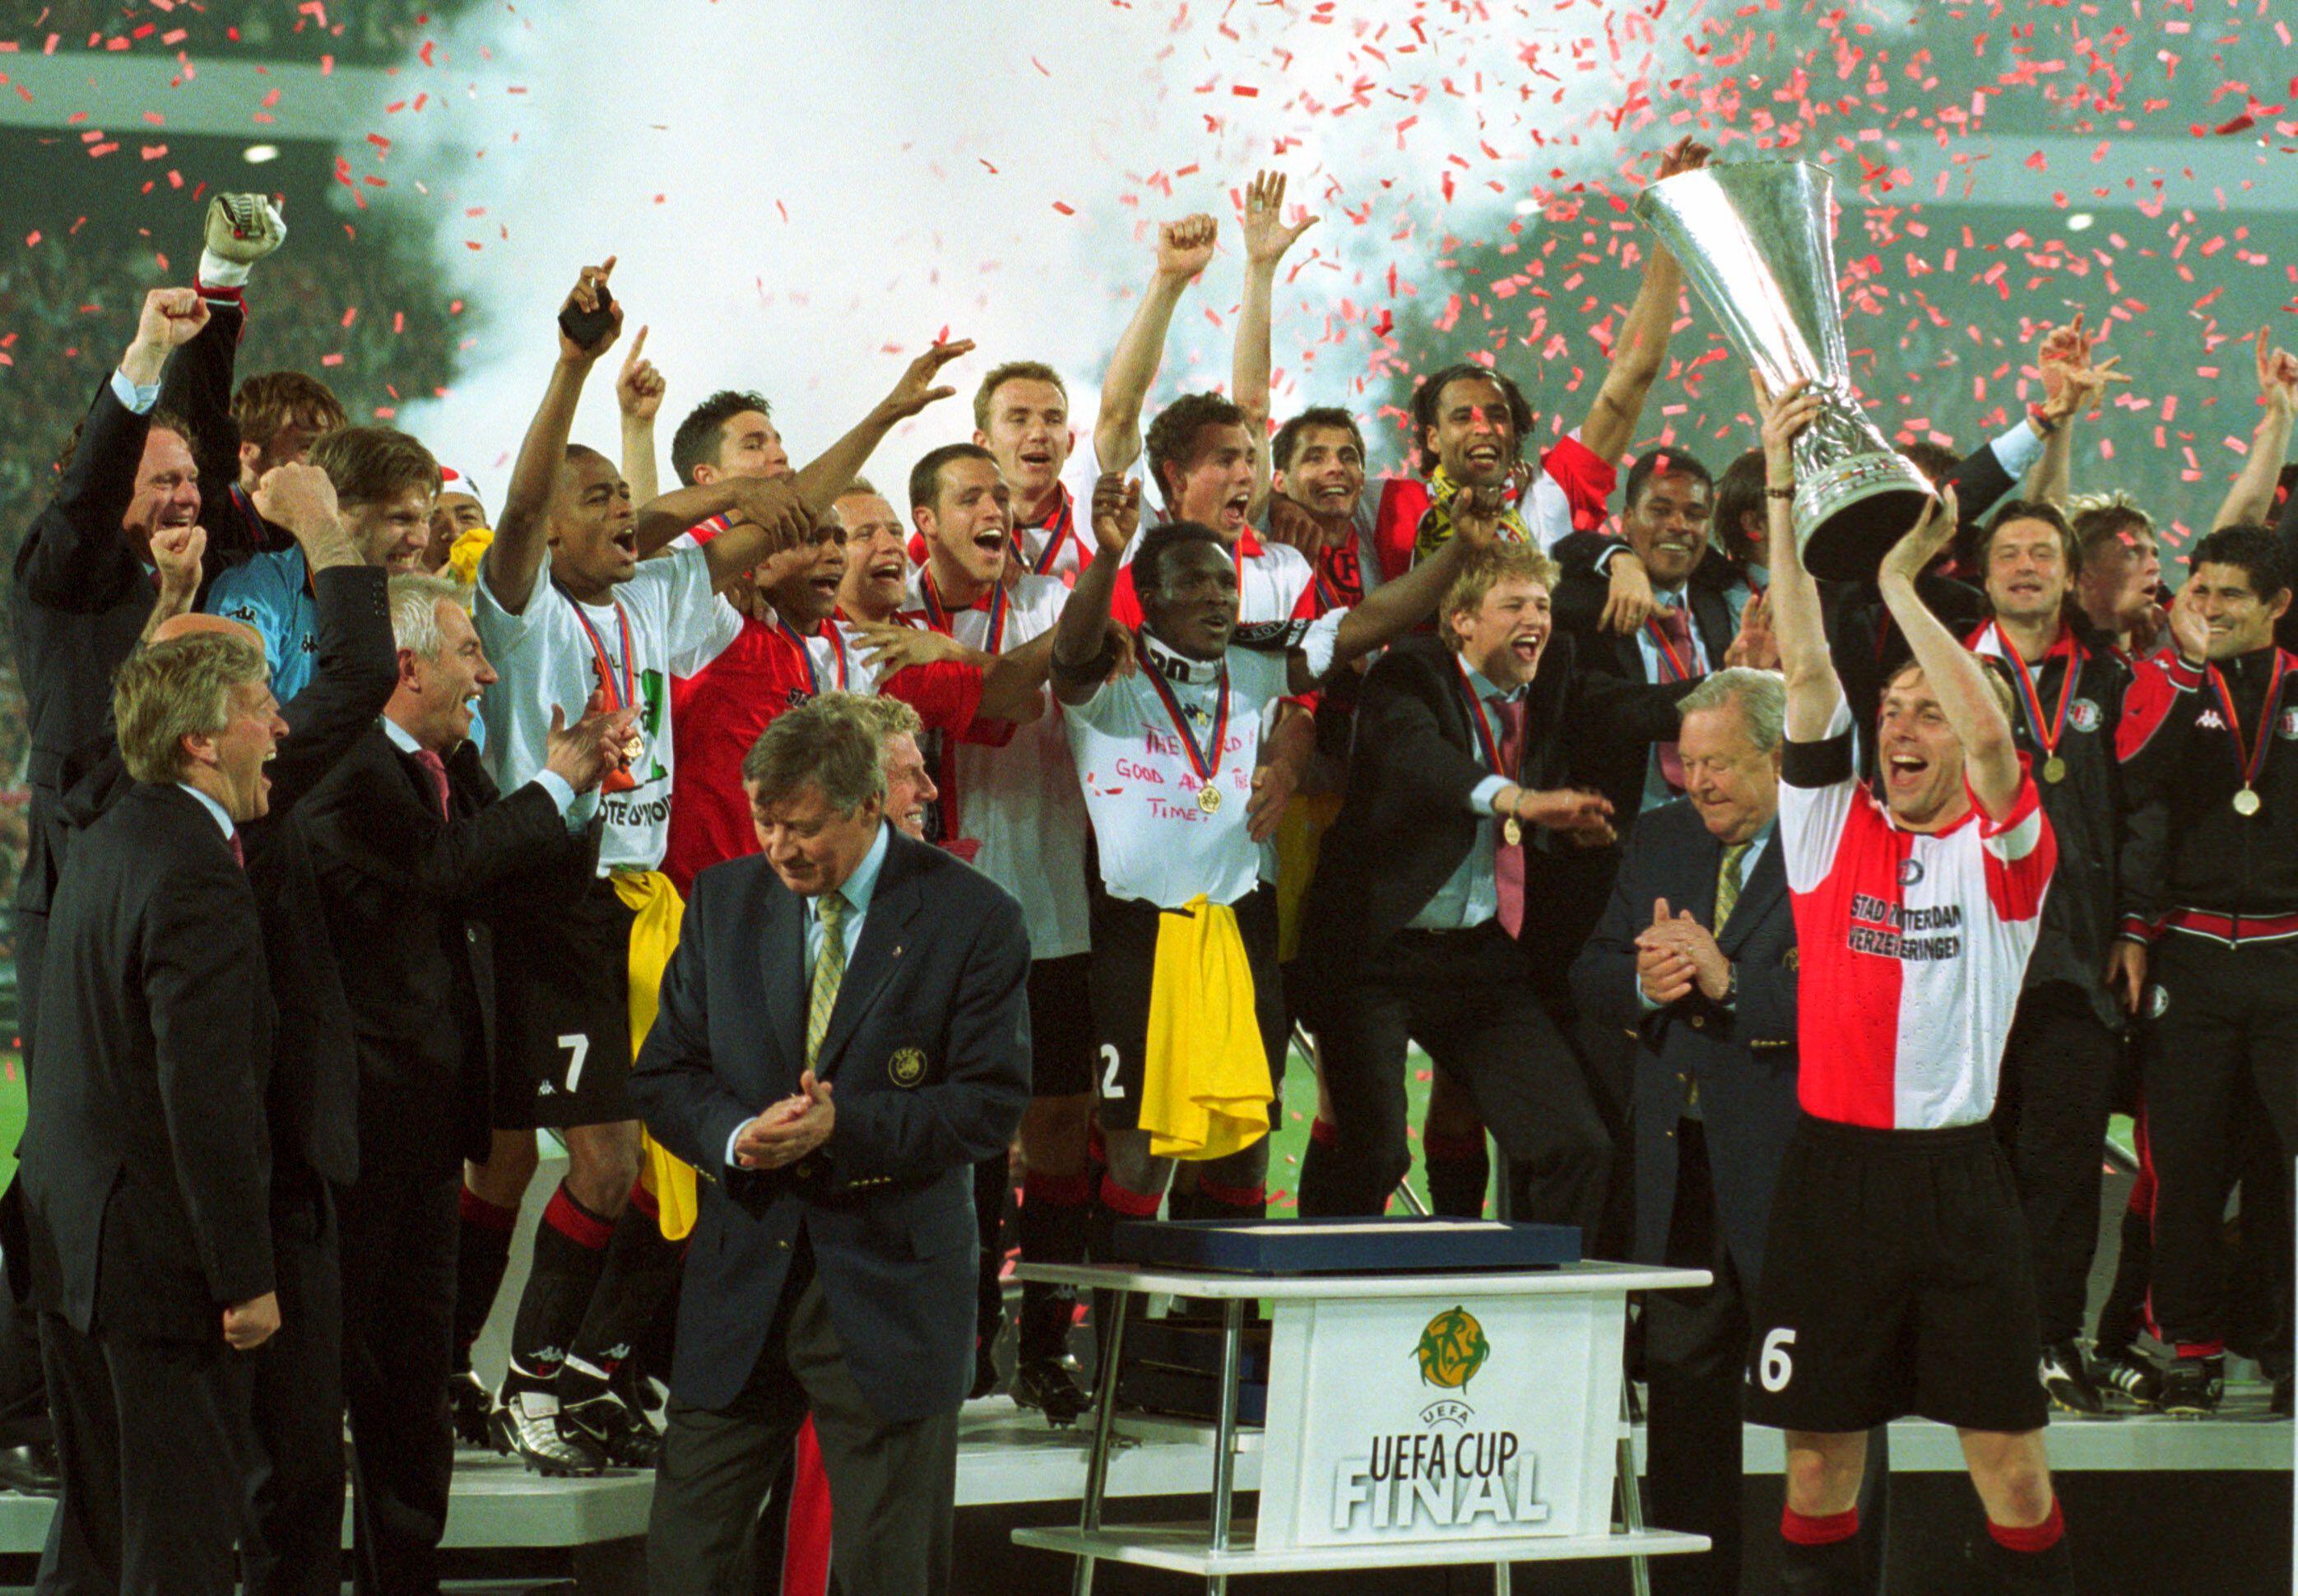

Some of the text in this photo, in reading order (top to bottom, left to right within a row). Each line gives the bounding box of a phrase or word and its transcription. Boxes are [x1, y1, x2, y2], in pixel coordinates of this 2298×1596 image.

[1140, 722, 1180, 756] THE
[1116, 758, 1165, 784] GOOD
[1850, 893, 1887, 923] STAD
[558, 1033, 589, 1093] 7
[1100, 1043, 1125, 1098] 2
[1760, 1328, 1796, 1392] 6
[1423, 1405, 1468, 1424] UEFA
[1370, 1431, 1519, 1482] UEFA CUP
[1333, 1453, 1547, 1529] FINAL
